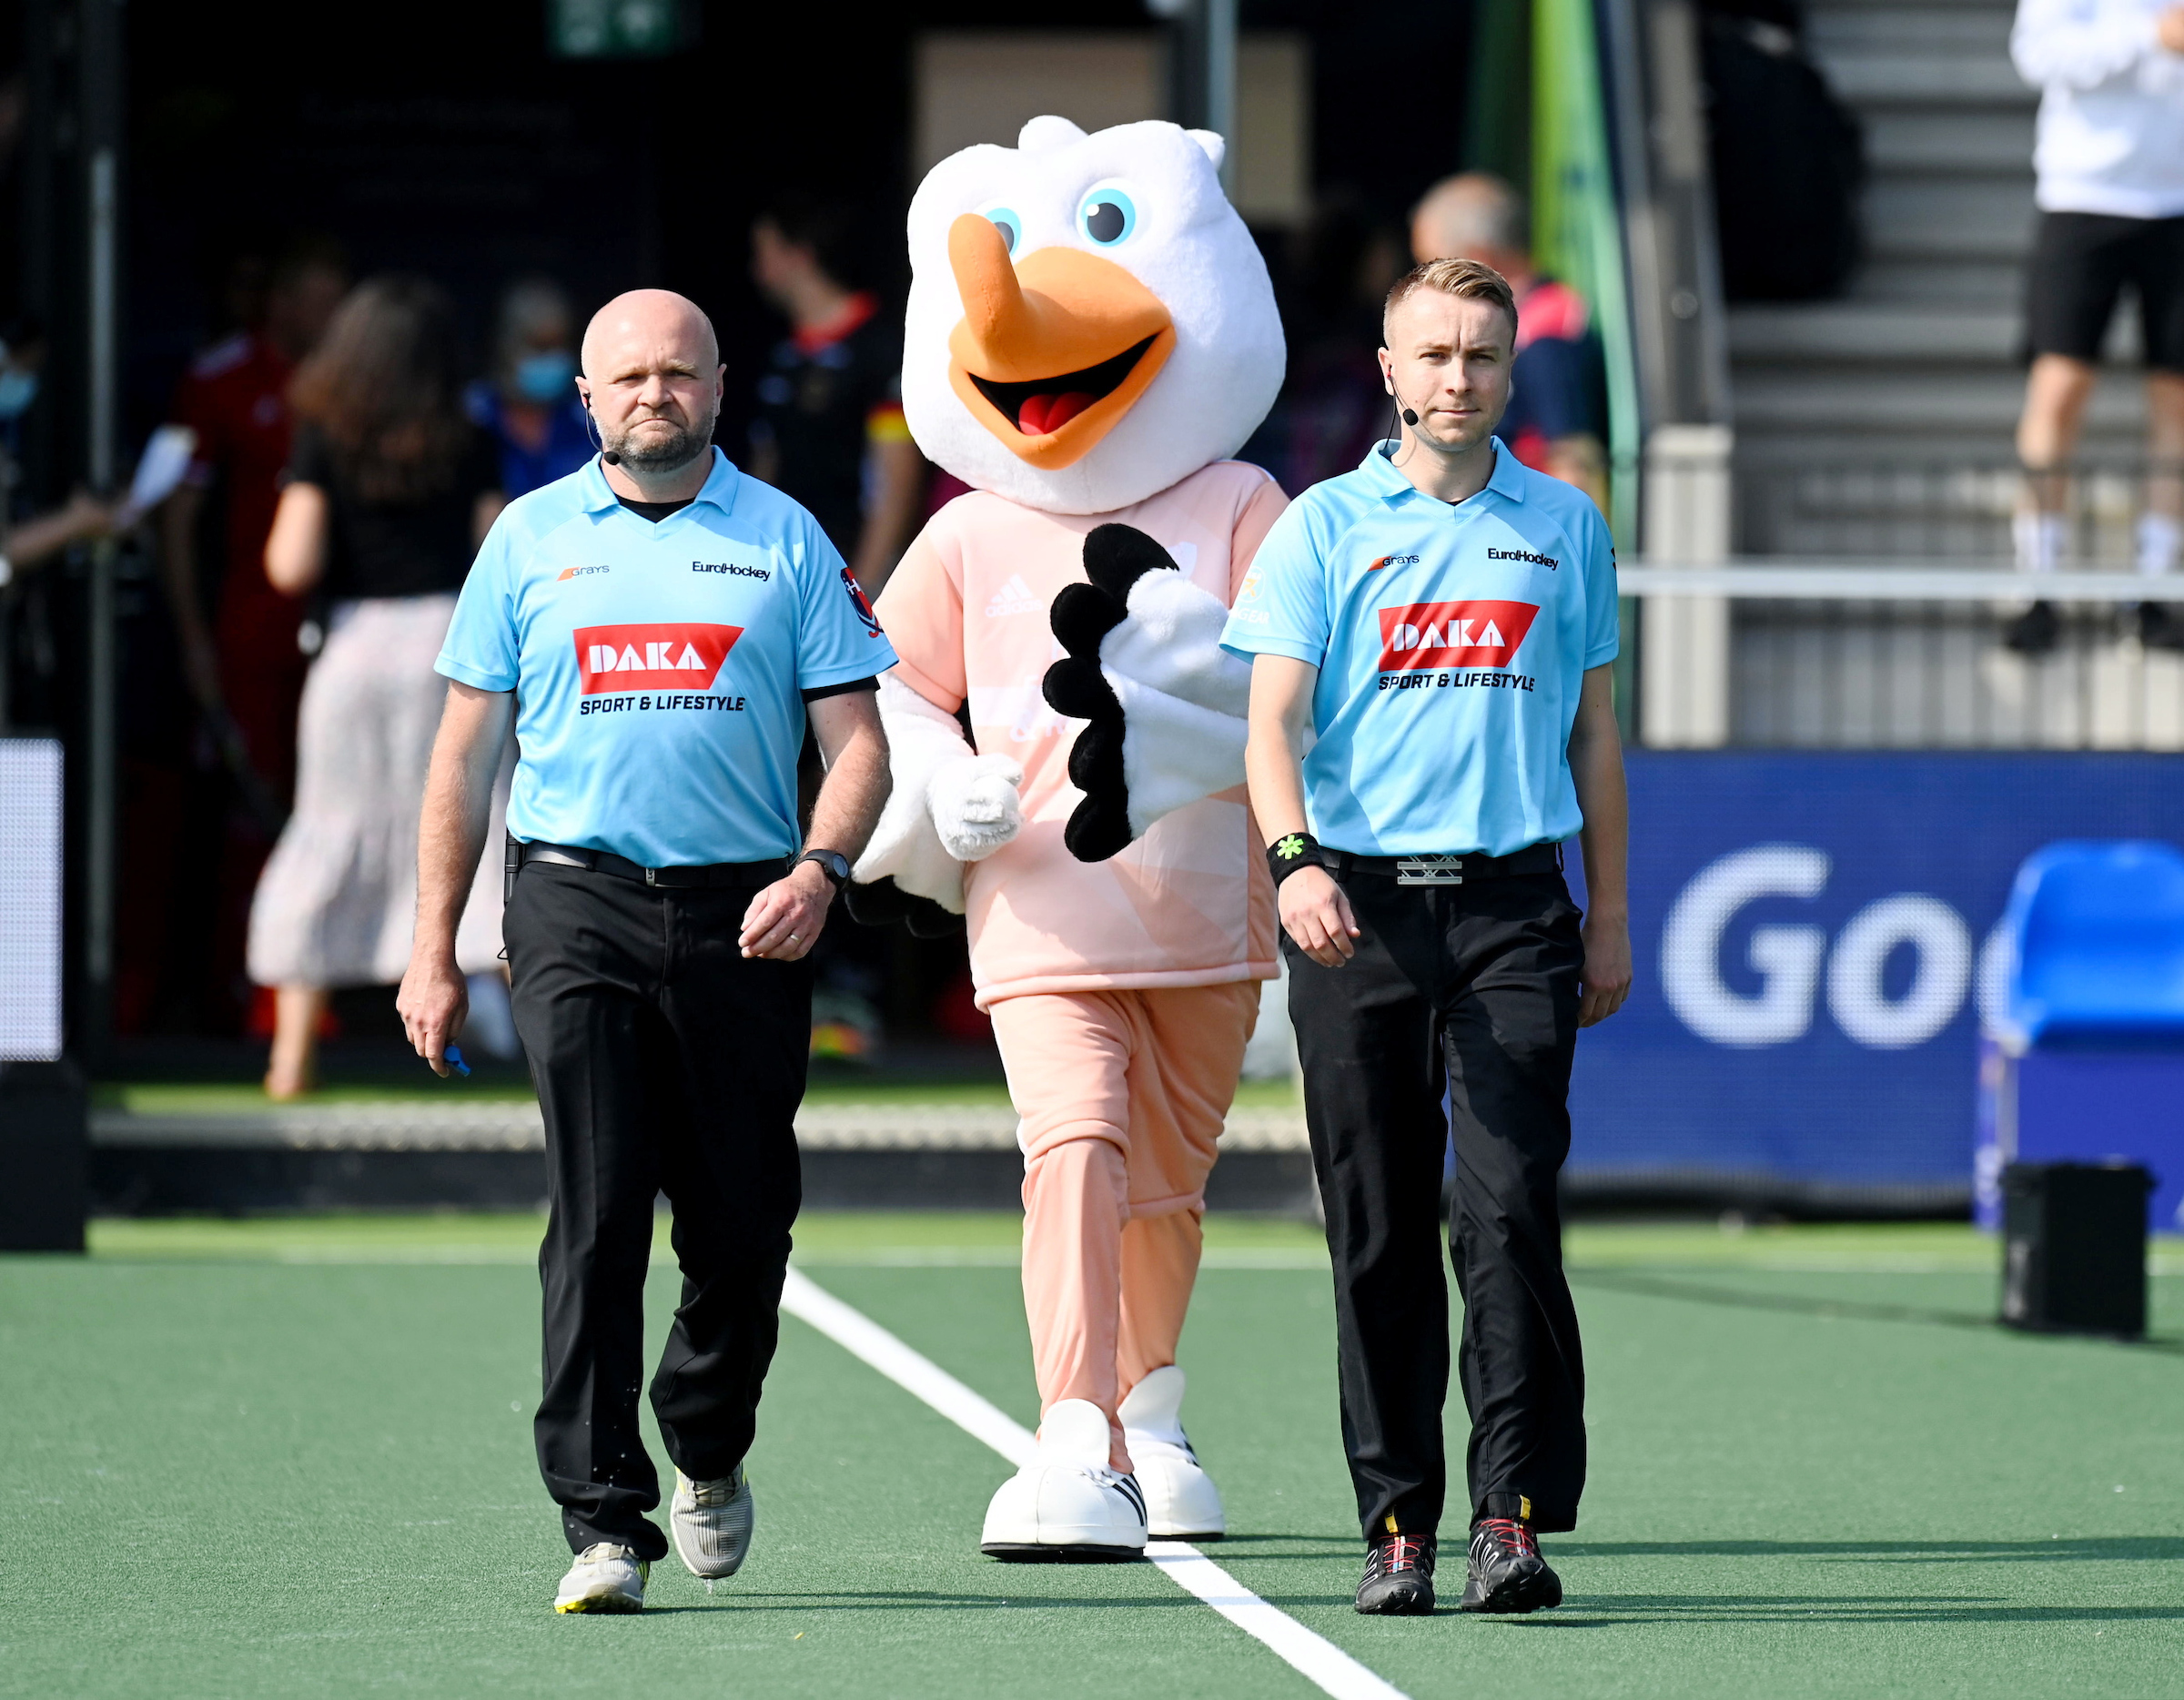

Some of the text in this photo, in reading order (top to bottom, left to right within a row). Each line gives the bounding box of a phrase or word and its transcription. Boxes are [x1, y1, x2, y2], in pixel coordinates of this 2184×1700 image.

[985, 598, 1044, 618] adidas
[1393, 619, 1505, 652] DAKA
[589, 642, 707, 673] DAKA
[1379, 673, 1535, 692] SPORT & LIFESTYLE
[581, 695, 745, 715] SPORT & LIFESTYLE
